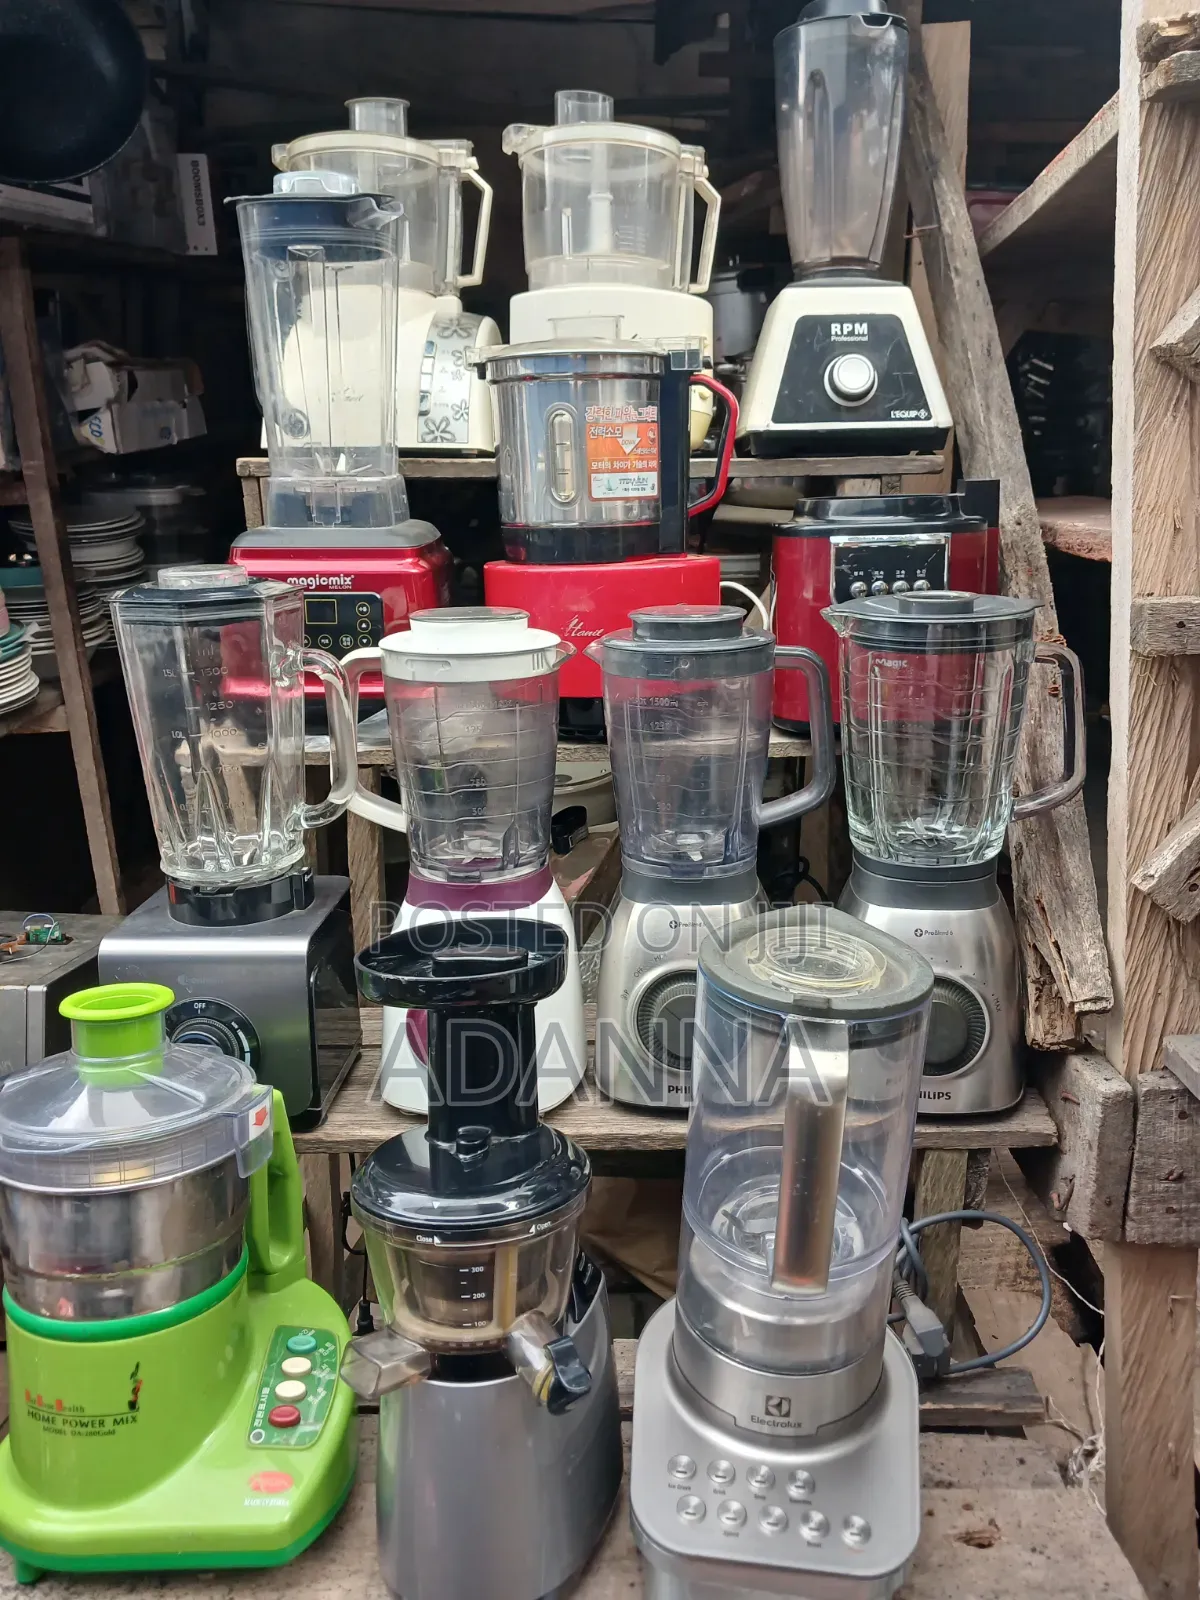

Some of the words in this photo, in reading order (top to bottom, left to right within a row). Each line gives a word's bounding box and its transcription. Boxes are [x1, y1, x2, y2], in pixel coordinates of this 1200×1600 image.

[830, 322, 868, 335] RPM
[585, 405, 613, 422] 강력한
[286, 574, 353, 589] magicmix
[201, 667, 229, 677] 1500
[205, 700, 234, 711] 1250
[210, 728, 238, 739] 1000
[416, 1234, 433, 1243] Close
[472, 1292, 486, 1300] 200
[27, 1409, 56, 1426] HOME
[62, 1418, 106, 1429] POWER
[112, 1414, 138, 1427] MIX
[750, 1414, 803, 1428] Electrolux
[42, 1425, 68, 1437] MODEL
